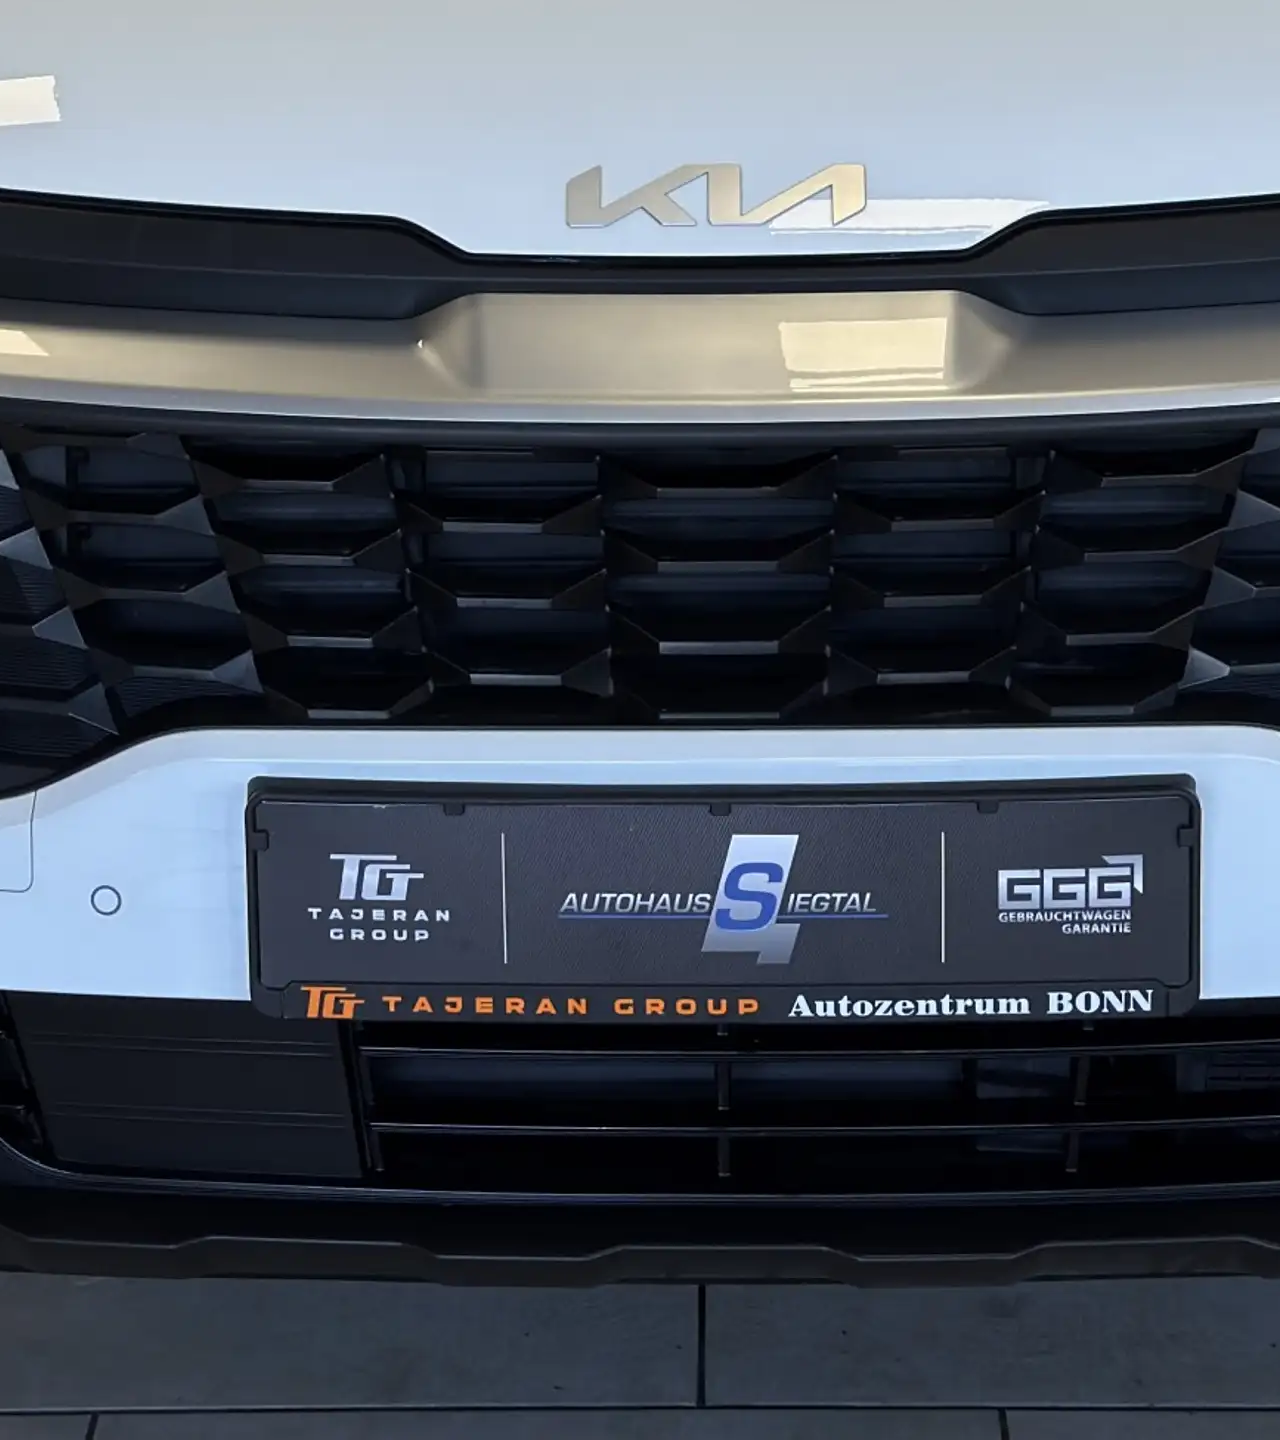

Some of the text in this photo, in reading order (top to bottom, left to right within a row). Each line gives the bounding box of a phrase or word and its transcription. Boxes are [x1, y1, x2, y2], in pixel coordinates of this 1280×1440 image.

[566, 163, 867, 228] KIA
[998, 866, 1132, 910] GGG
[560, 891, 711, 913] AUTOHAUS
[307, 907, 450, 922] TAJERAN
[997, 909, 1132, 923] GEBRAUCHTWAGEN
[329, 927, 429, 942] GROUP
[1061, 921, 1132, 935] GARANTIE
[382, 995, 588, 1015] TAJERAN
[614, 998, 760, 1015] GROUP
[788, 993, 1031, 1018] Autozentrum
[1046, 989, 1154, 1015] BONN
